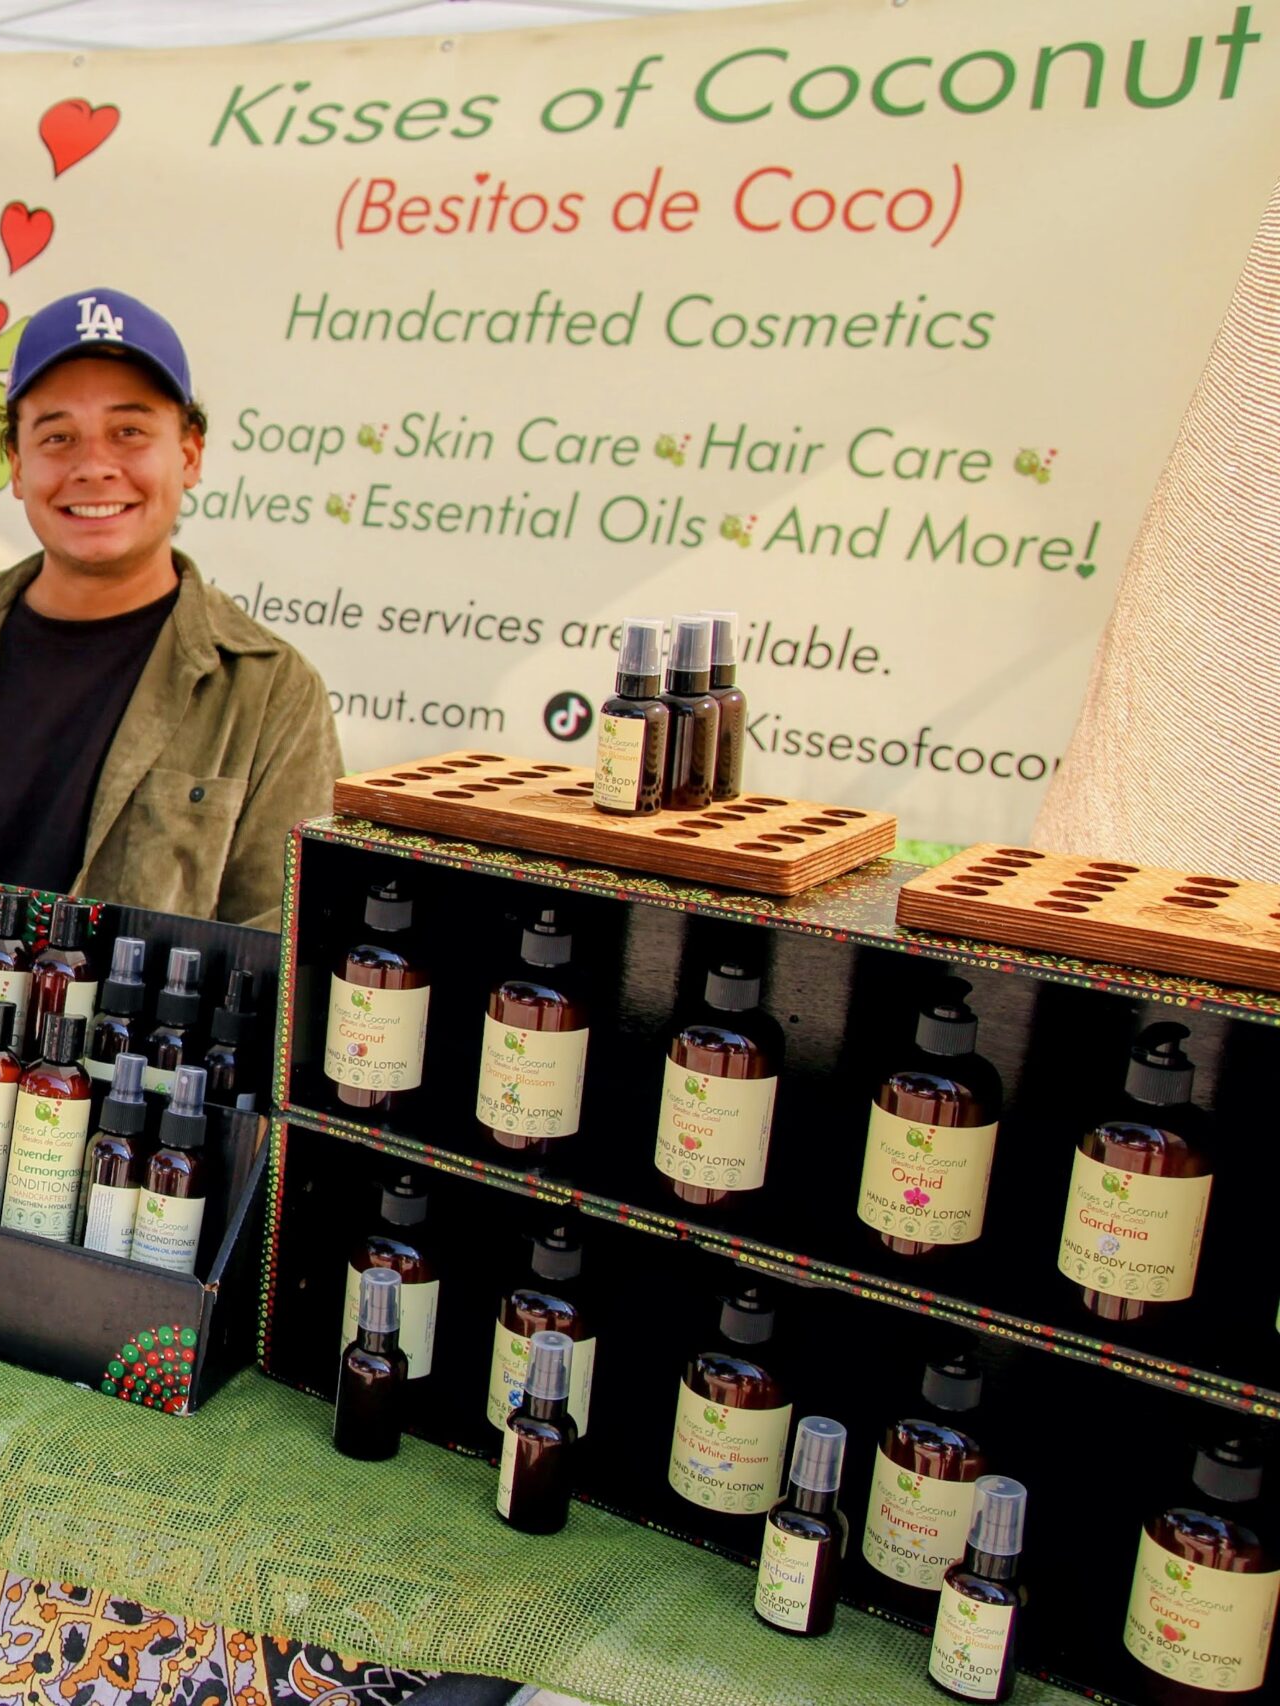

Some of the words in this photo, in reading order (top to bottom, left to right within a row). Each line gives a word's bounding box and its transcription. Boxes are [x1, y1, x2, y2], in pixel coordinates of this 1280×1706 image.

[209, 81, 500, 147] Kisses
[540, 55, 664, 134] of
[693, 5, 1262, 124] Coconut
[335, 172, 584, 250] (Besitos
[612, 167, 700, 233] de
[734, 163, 963, 248] Coco)
[75, 296, 124, 341] LA
[285, 290, 643, 346] Handcrafted
[665, 294, 995, 349] Cosmetics
[232, 408, 345, 466] Soap
[394, 412, 494, 459] Skin
[517, 416, 640, 467] Care
[699, 423, 825, 474] Hair
[847, 427, 993, 483] Care
[361, 484, 580, 540] Essential
[600, 495, 707, 548] Oils
[762, 505, 890, 559] And
[905, 512, 1101, 579] More!
[377, 600, 544, 645] services
[328, 690, 506, 733] onut.com
[612, 776, 637, 787] BODY
[364, 1013, 400, 1024] Coconut
[339, 1024, 385, 1043] Coconut
[349, 1057, 372, 1067] BODY
[374, 1061, 407, 1070] LOTION
[517, 1056, 556, 1069] Coconut
[516, 1074, 555, 1087] Blossom
[501, 1102, 525, 1115] BODY
[527, 1107, 563, 1117] LOTION
[698, 1102, 739, 1117] Coconut
[673, 1114, 713, 1136] Guava
[12, 1142, 64, 1162] Lavender
[678, 1148, 705, 1162] BODY
[707, 1156, 745, 1167] LOTION
[880, 1141, 905, 1159] Kisses
[909, 1152, 919, 1162] of
[923, 1154, 967, 1168] Coconut
[892, 1167, 943, 1189] Orchid
[866, 1189, 889, 1206] HAND
[899, 1205, 931, 1219] BODY
[933, 1210, 971, 1220] LOTION
[1103, 1199, 1114, 1209] of
[1118, 1201, 1168, 1219] Coconut
[1079, 1209, 1149, 1240] Gardenia
[1093, 1253, 1126, 1269] BODY
[1128, 1262, 1175, 1274] LOTION
[717, 1431, 759, 1446] Coconut
[698, 1442, 727, 1460] White
[729, 1452, 769, 1463] Blossom
[697, 1474, 725, 1489] BODY
[727, 1483, 764, 1491] LOTION
[911, 1500, 956, 1517] Coconut
[880, 1503, 938, 1537] Plumeria
[891, 1544, 920, 1560] BODY
[763, 1559, 805, 1585] atchouli
[778, 1596, 807, 1610] BODY
[1180, 1590, 1234, 1612] Coconut
[1149, 1596, 1200, 1629] Guava
[1156, 1636, 1190, 1656] BODY
[1193, 1651, 1241, 1665] LOTION
[941, 1661, 981, 1683] LOTION
[969, 1664, 999, 1677] BODY
